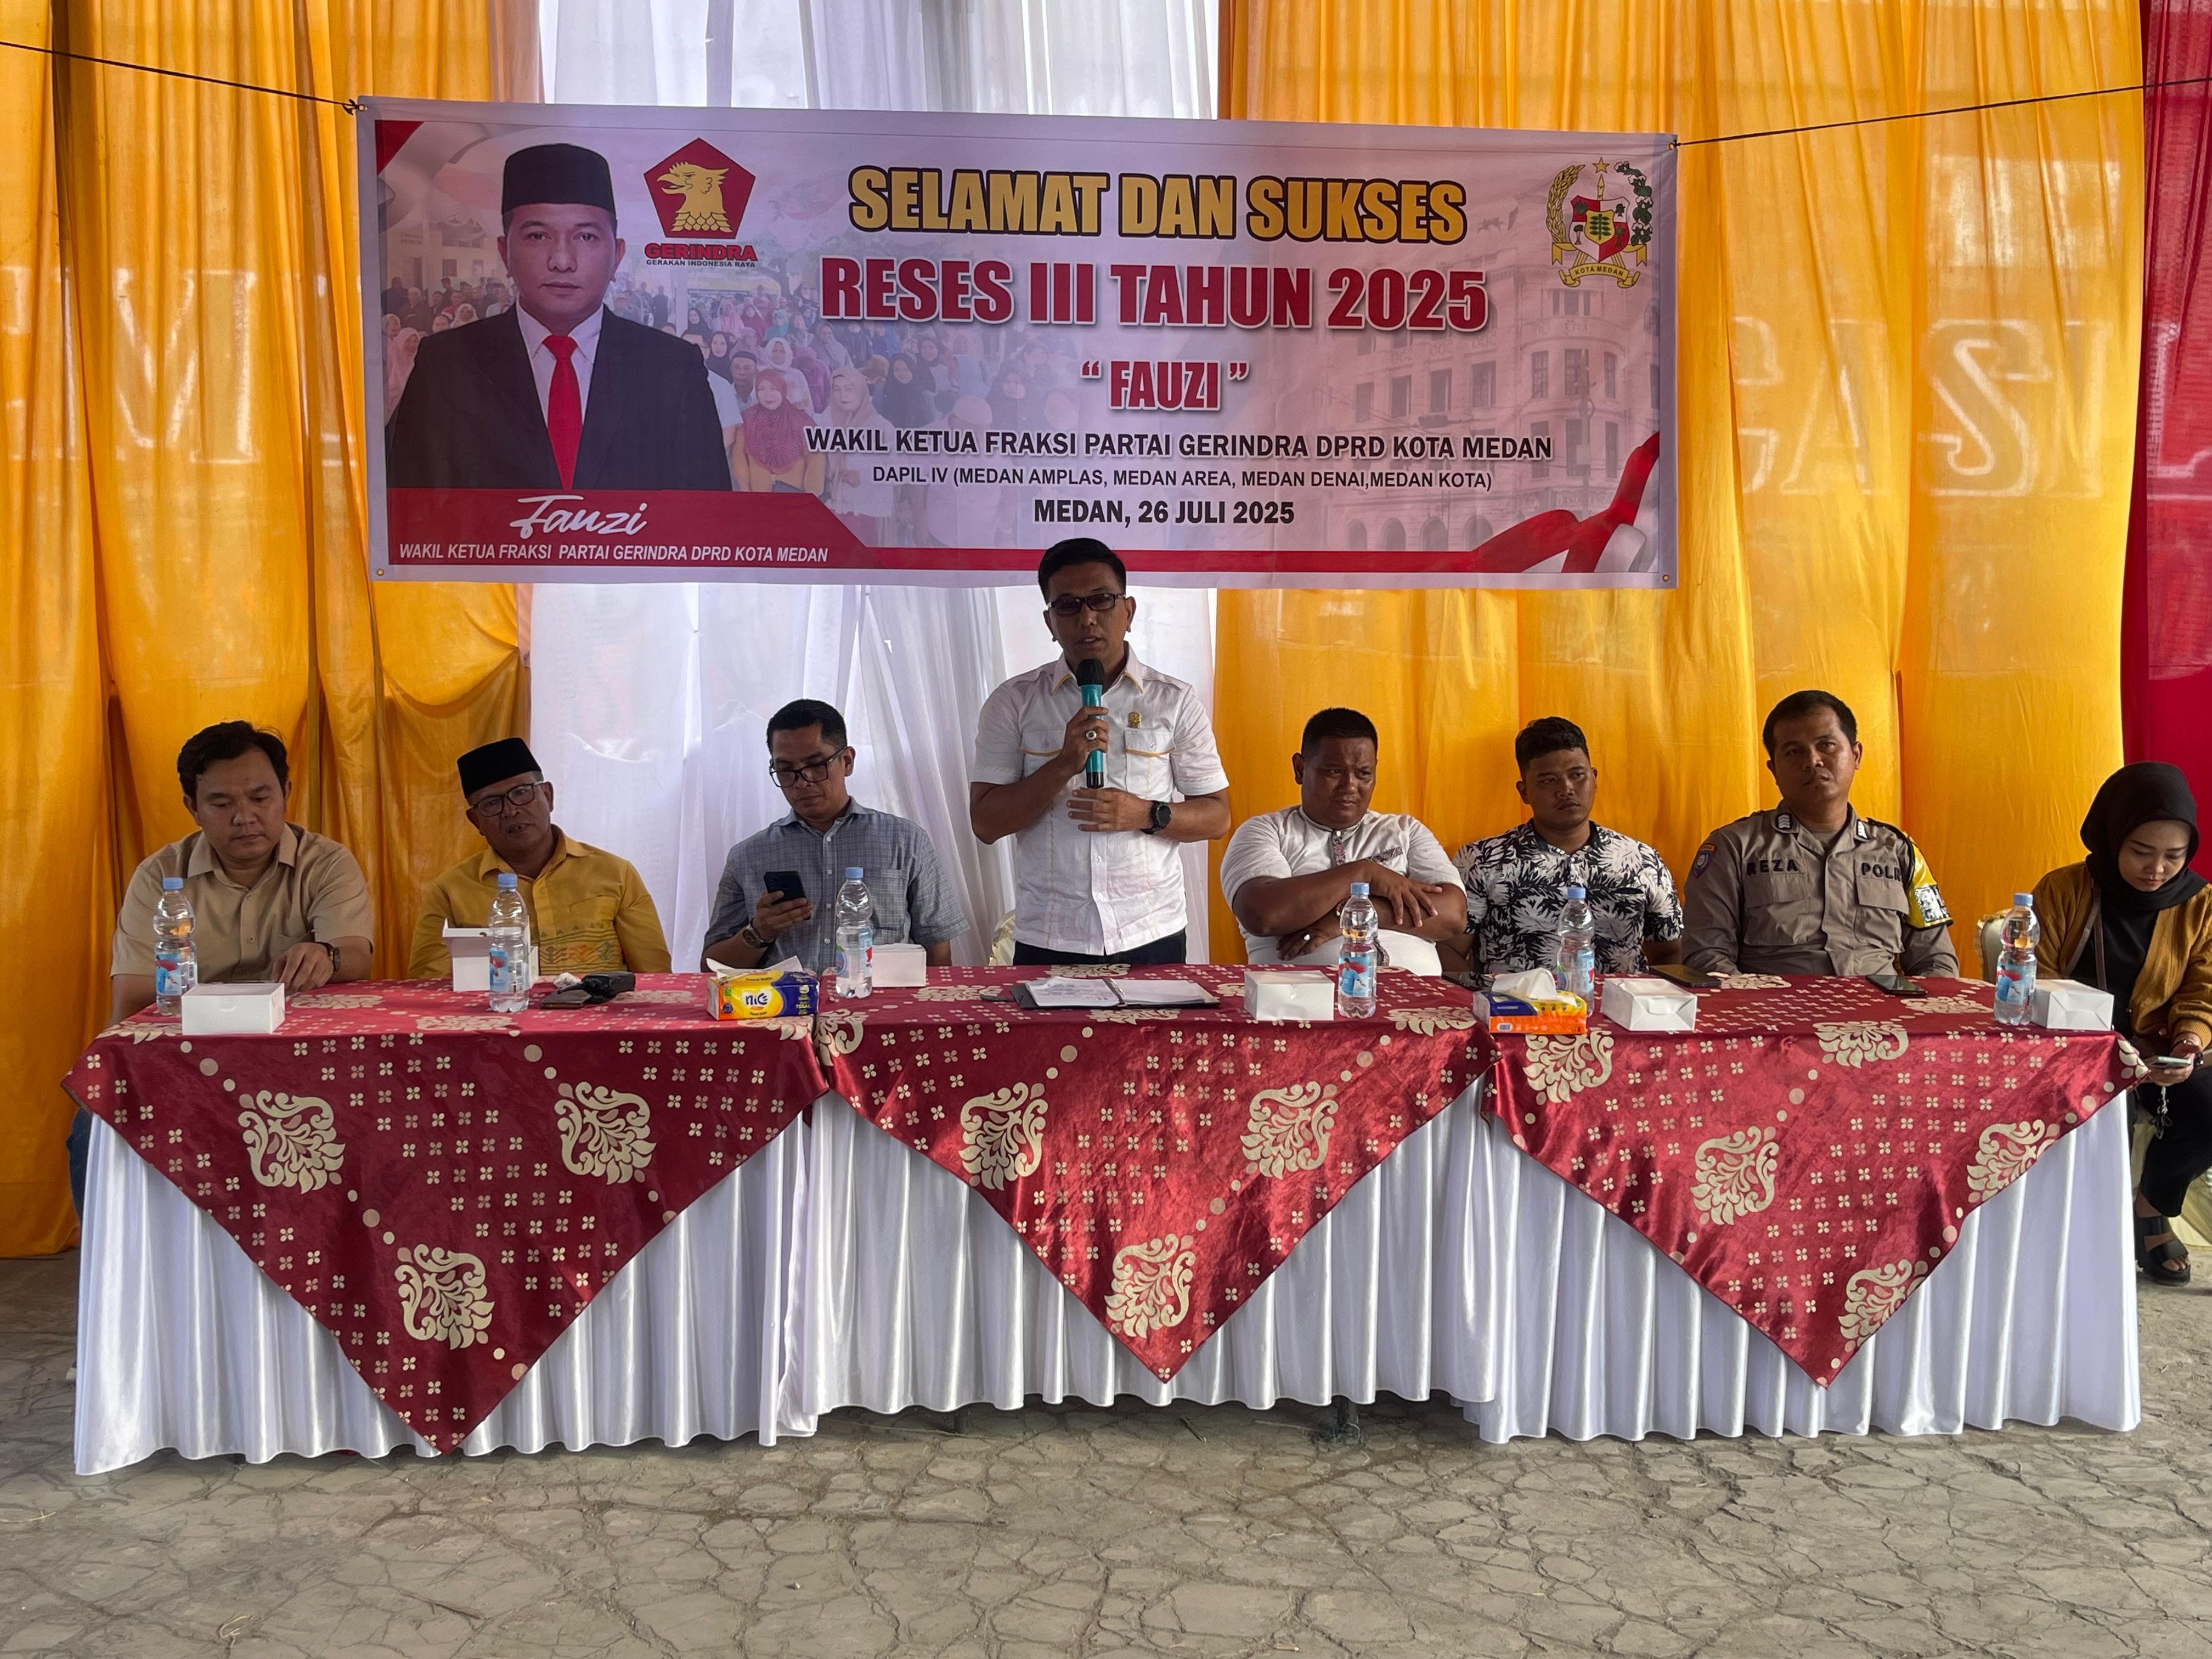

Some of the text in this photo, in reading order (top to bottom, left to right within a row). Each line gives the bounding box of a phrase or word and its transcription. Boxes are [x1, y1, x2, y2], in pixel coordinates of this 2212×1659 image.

[848, 165, 1467, 245] SELAMAT DAN SUKSES
[645, 242, 758, 261] GERINDRA
[1575, 266, 1623, 276] KOTA MEDAN
[823, 258, 1485, 329] RESES III TAHUN 2025
[806, 428, 1550, 458] WAKIL KETUA FRAKSI PARTAI GERINDRA DPRD KOTA MEDAN
[874, 467, 926, 482] DAPIL
[932, 468, 948, 482] IV
[954, 468, 1023, 487] (MEDAN
[1029, 470, 1107, 487] AMPLAS,
[1114, 471, 1176, 485] MEDAN
[1182, 471, 1235, 488] AREA,
[1243, 471, 1304, 486] MEDAN
[1440, 473, 1491, 492] KOTA)
[510, 495, 647, 539] Fauzi
[1035, 500, 1294, 528] MEDAN, 26 JULI 2025
[400, 544, 828, 562] WAKIL KETUA FRAKSI PARTAI GERINDRA DPRD KOTA MEDAN
[1747, 859, 1798, 876] REZA
